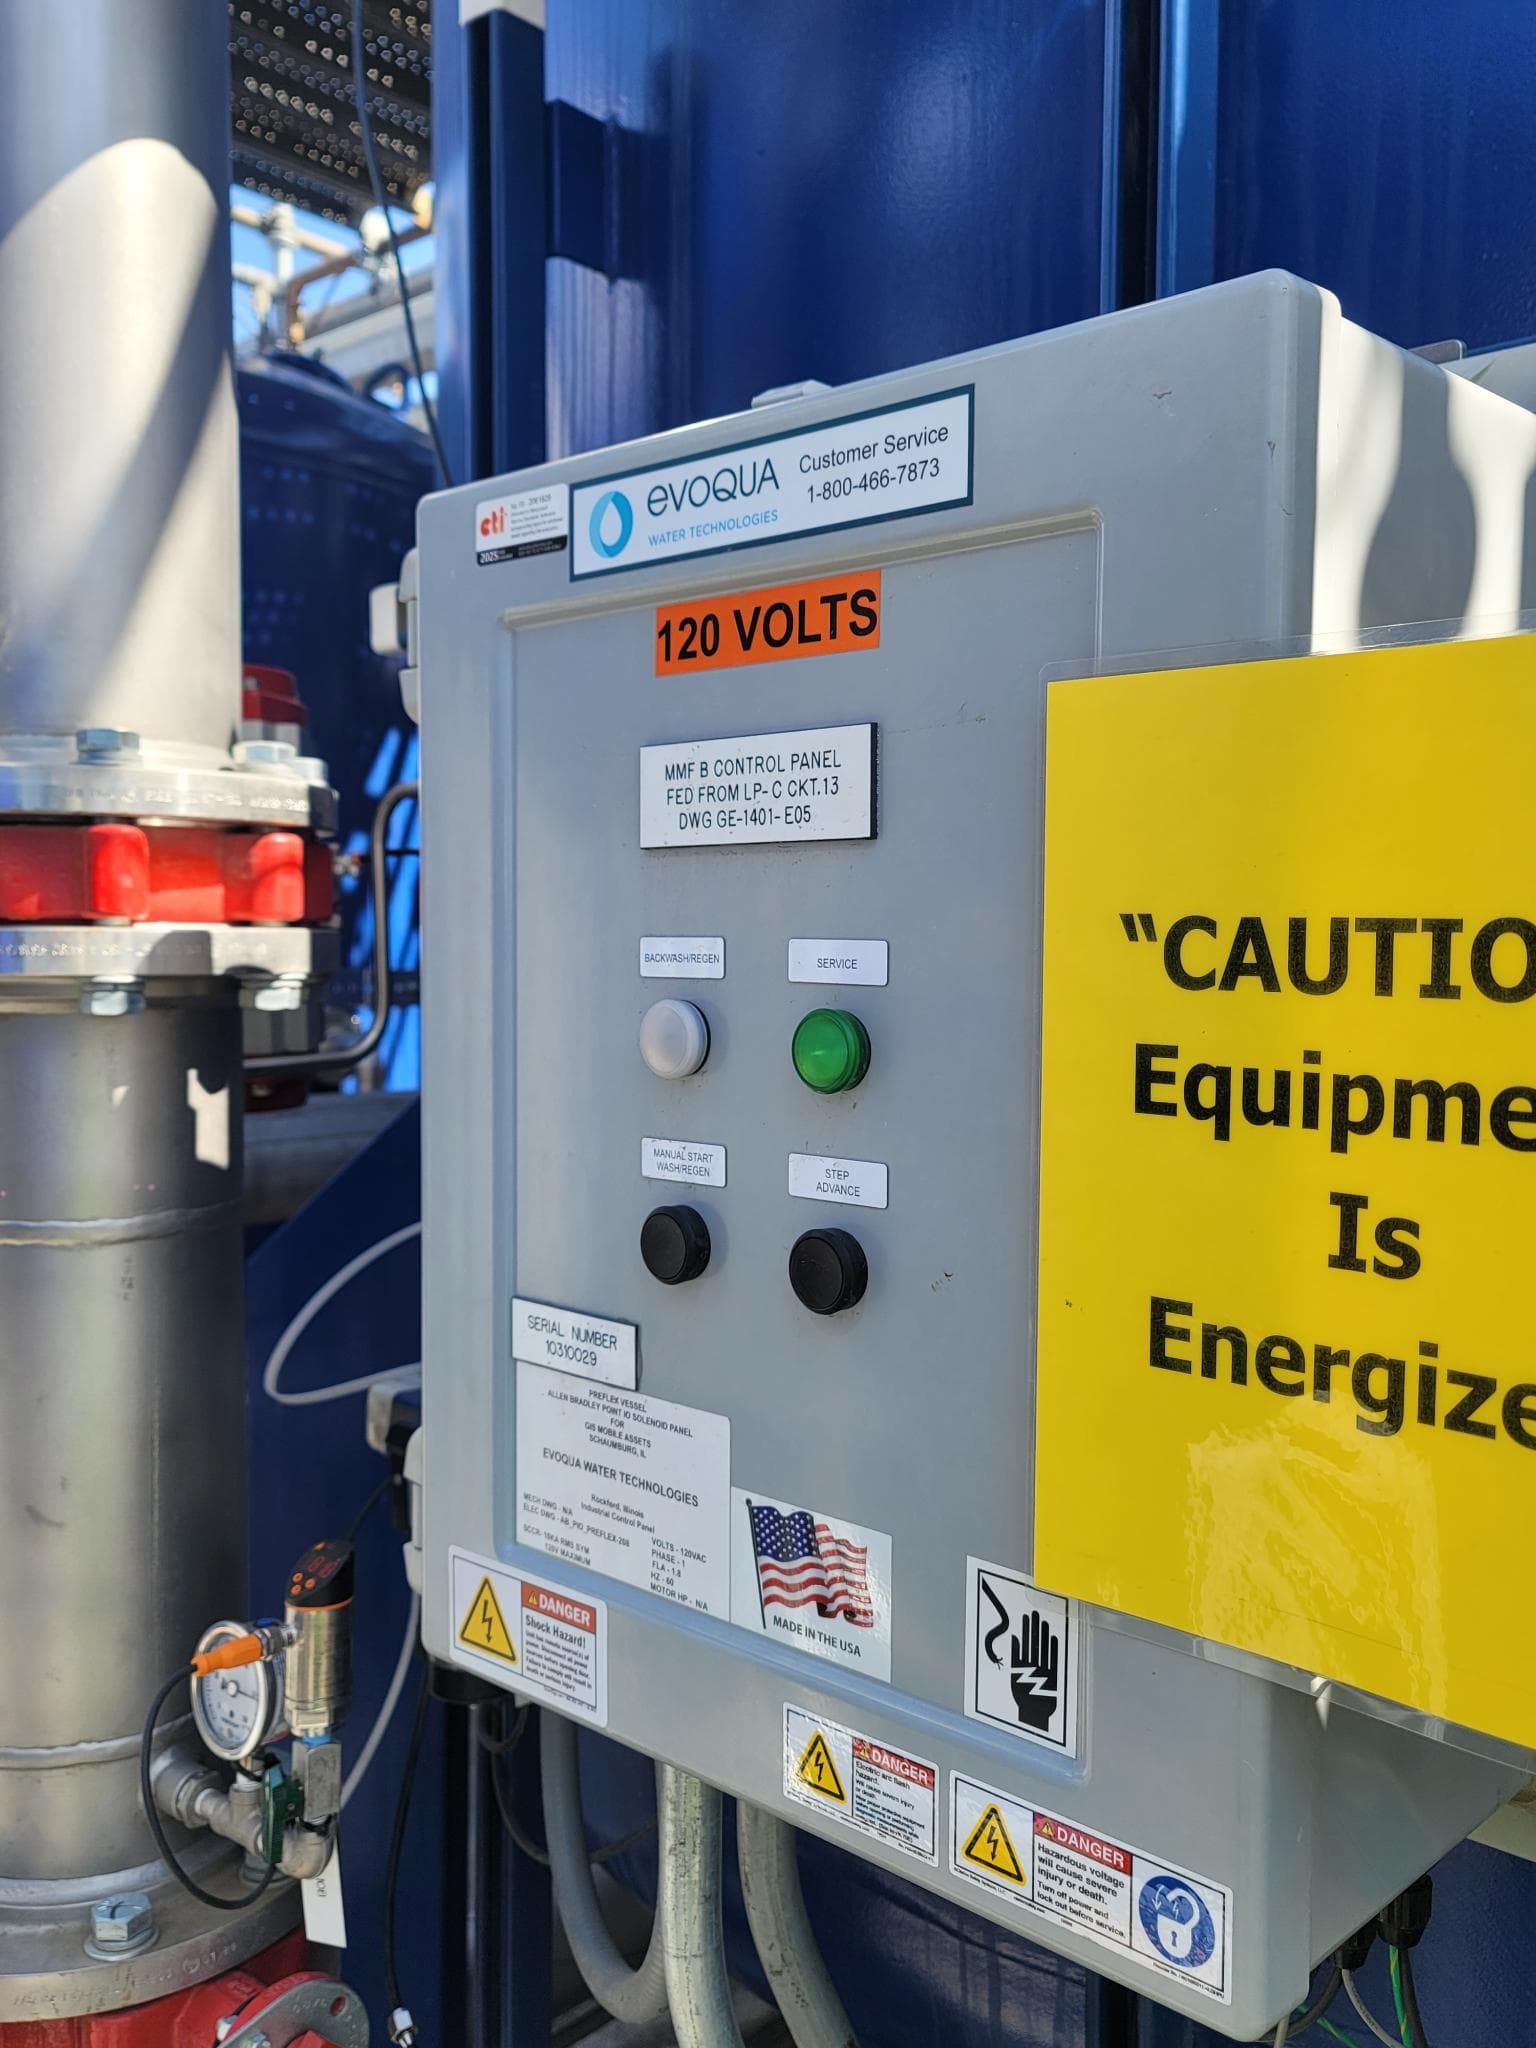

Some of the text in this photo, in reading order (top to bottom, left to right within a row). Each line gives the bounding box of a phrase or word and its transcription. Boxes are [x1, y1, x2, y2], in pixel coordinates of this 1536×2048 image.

[799, 424, 949, 475] Customer Service
[807, 458, 940, 504] 1-800-466-7873
[648, 509, 779, 548] WATER TECHNOLOGIES
[657, 588, 879, 663] 120 VOLTS
[665, 749, 842, 781] MMF B CONTROL PANEL
[667, 787, 693, 806] FED
[698, 784, 740, 803] FROM
[788, 776, 839, 798] CKT.13
[679, 810, 712, 830] DWG
[644, 953, 720, 964] BACKWASH/REGEN
[817, 958, 858, 969] SERVICE
[1134, 1043, 1536, 1153] Equipme
[654, 1148, 714, 1164] MANUAL START
[656, 1161, 711, 1177] WASH/REGEN
[815, 1183, 861, 1197] ADVANCE
[825, 1168, 850, 1180] STEP
[1328, 1191, 1422, 1280] Is
[527, 1315, 617, 1350] SERIAL NUMBER
[546, 1340, 597, 1367] 10310029
[547, 1389, 569, 1402] ALLEN
[569, 1394, 600, 1412] BRADLEY
[601, 1403, 622, 1417] POINT
[632, 1410, 668, 1431] SOLENOID
[669, 1421, 693, 1438] PANEL
[620, 1396, 647, 1413] VESSEL
[597, 1425, 623, 1440] MOBILE
[624, 1433, 651, 1448] ASSETS
[610, 1417, 625, 1429] FOR
[543, 1448, 699, 1507] EVOQUA WATER TECHNOLOGIES
[581, 1502, 655, 1534] Industrial Control Panel
[651, 1537, 674, 1551] VOLTS
[680, 1547, 707, 1564] 120VAC
[651, 1550, 675, 1565] PHASE
[651, 1572, 660, 1582] HZ
[651, 1583, 676, 1599] MOTOR
[538, 1593, 591, 1627] DANGER
[526, 1614, 551, 1634] Shock
[552, 1626, 586, 1650] Hazard!
[773, 1615, 862, 1657] MADE IN THE USA
[872, 1749, 928, 1785] DANGER
[1057, 1826, 1125, 1869] DANGER
[1038, 1842, 1125, 1889] Hazardous voltage
[1038, 1855, 1118, 1898] will cause severe
[1037, 1880, 1109, 1920] Turn off power and
[1038, 1866, 1107, 1906] injury or death.
[1037, 1891, 1053, 1906] lock
[1055, 1900, 1067, 1912] out
[1068, 1904, 1094, 1925] before
[1095, 1916, 1126, 1939] service.
